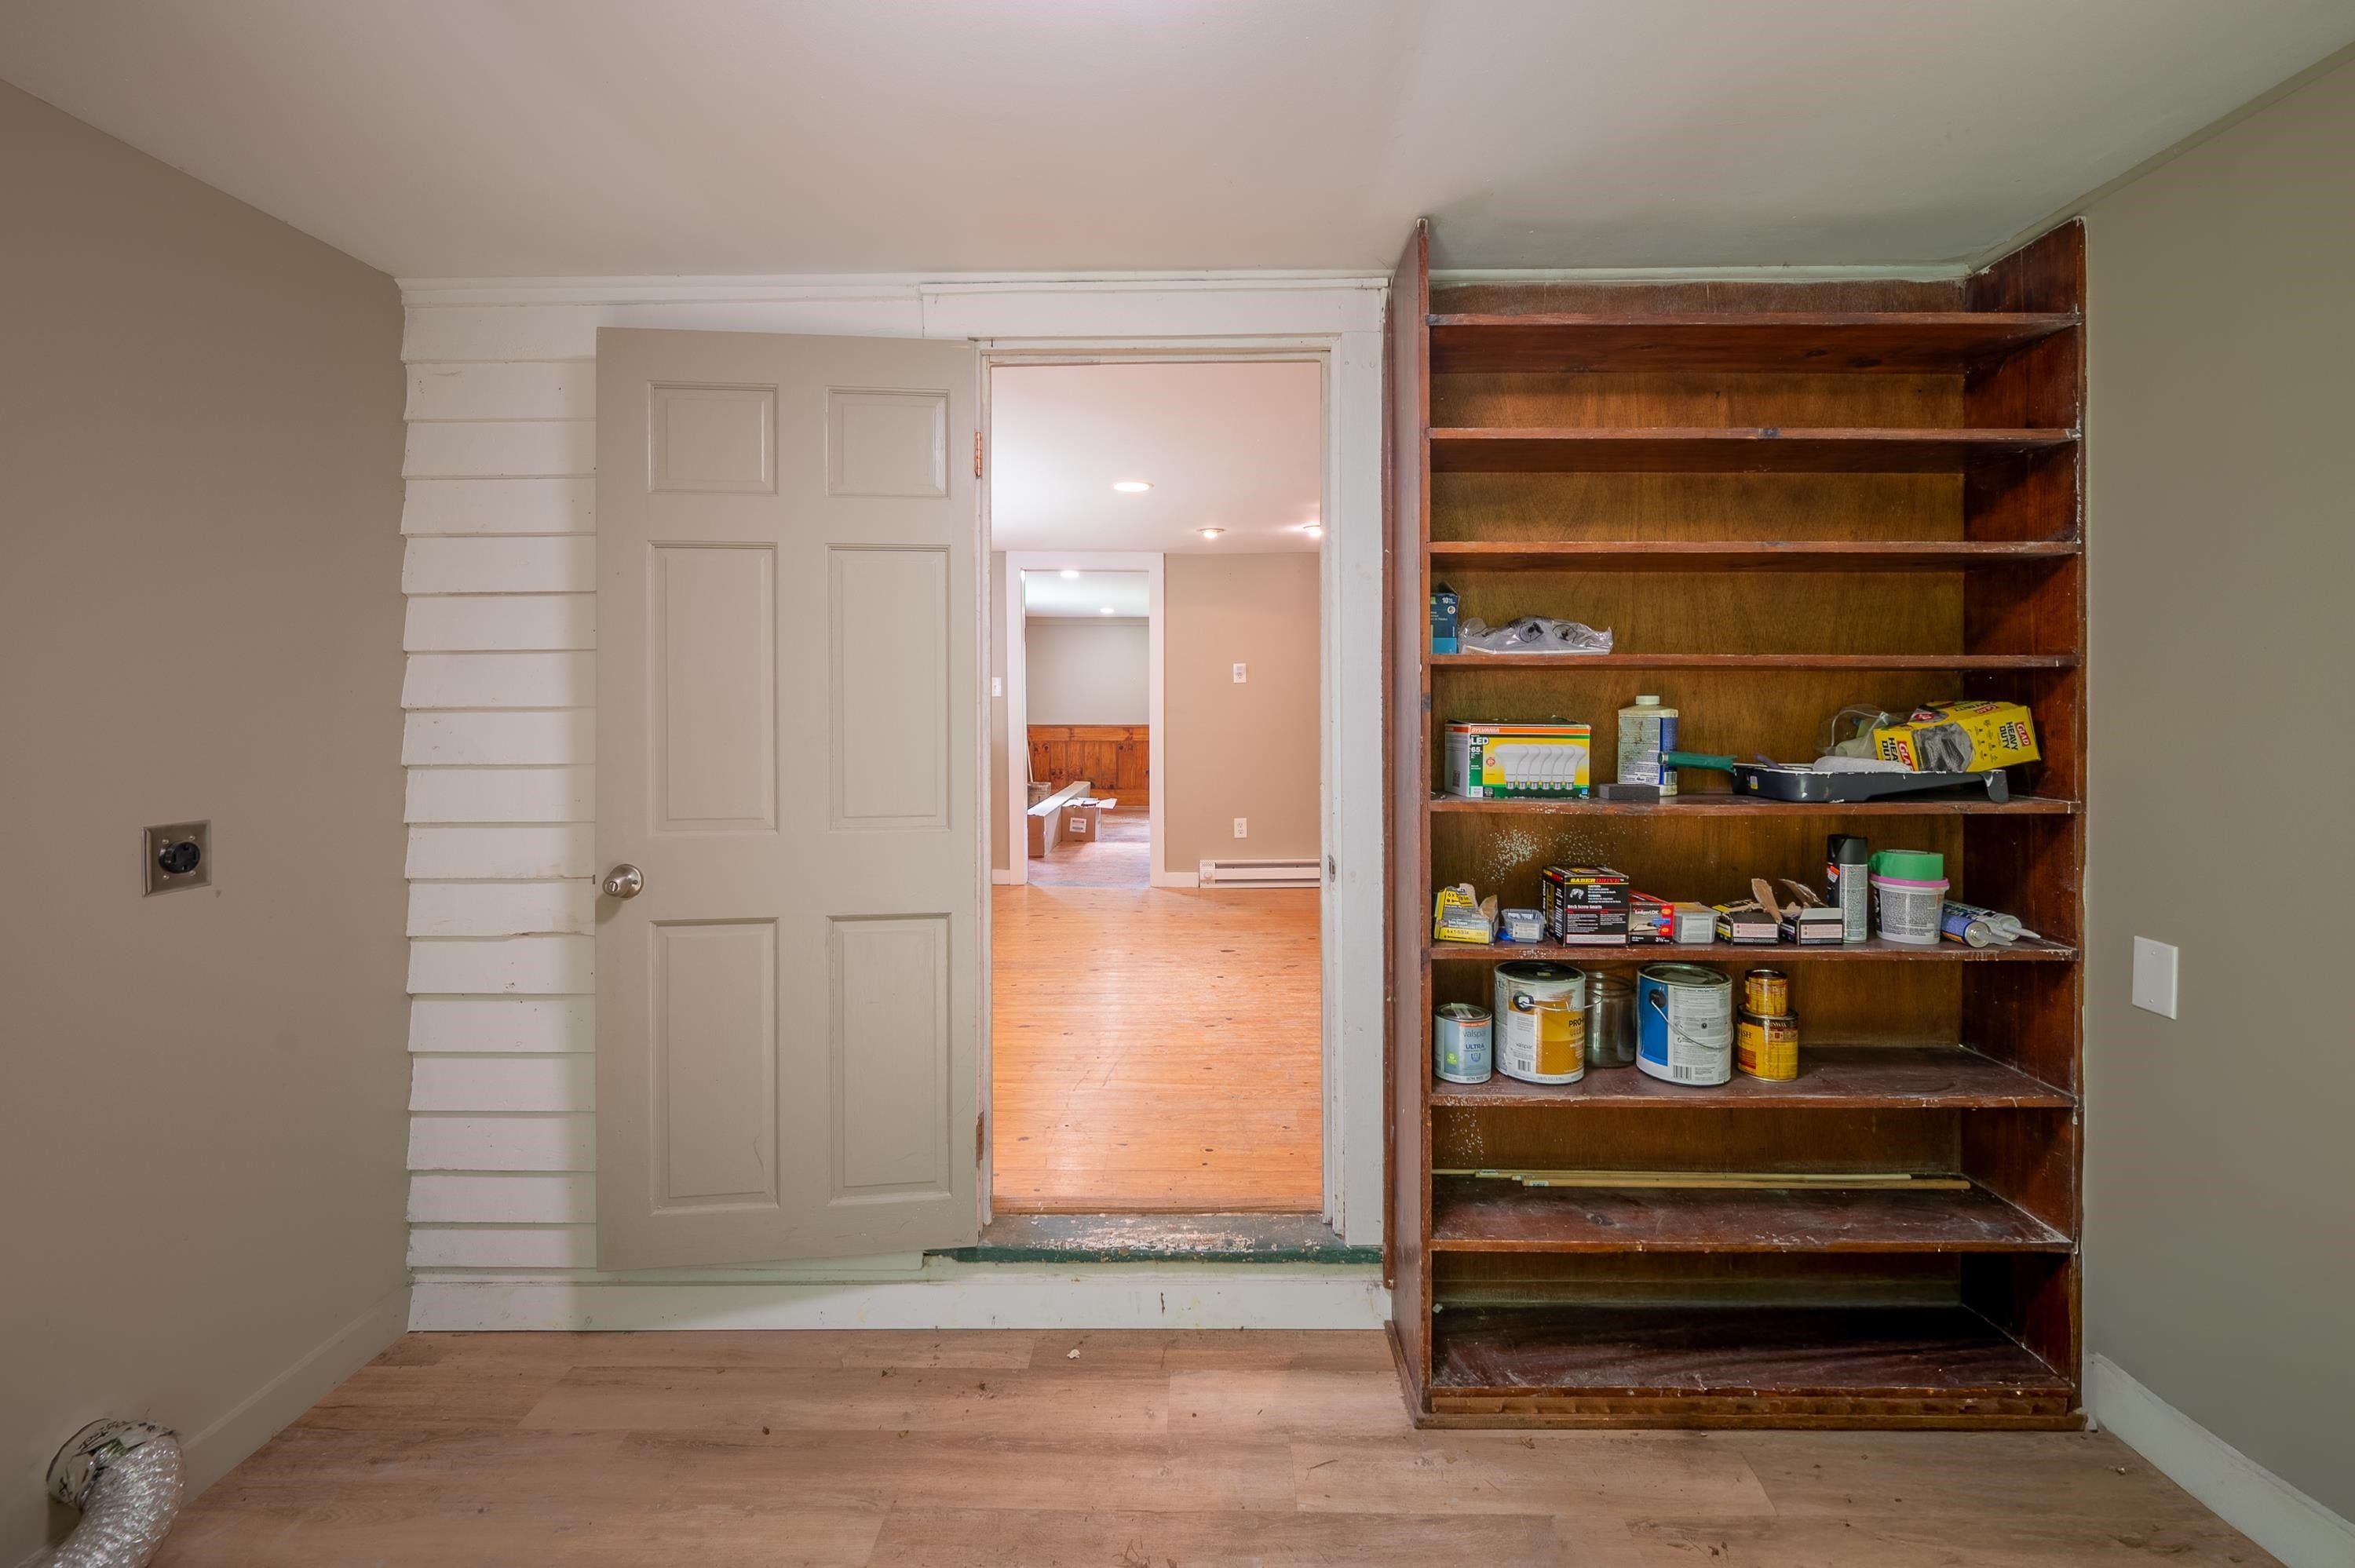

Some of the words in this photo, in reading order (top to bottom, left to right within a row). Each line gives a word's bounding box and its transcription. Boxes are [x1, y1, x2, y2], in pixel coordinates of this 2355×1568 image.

[1470, 736, 1489, 746] LED
[1999, 725, 2010, 749] DUTY
[2006, 721, 2018, 751] HEAVY
[2015, 723, 2031, 746] GLAD
[1888, 737, 1900, 763] HEA
[1898, 742, 1914, 771] GLA
